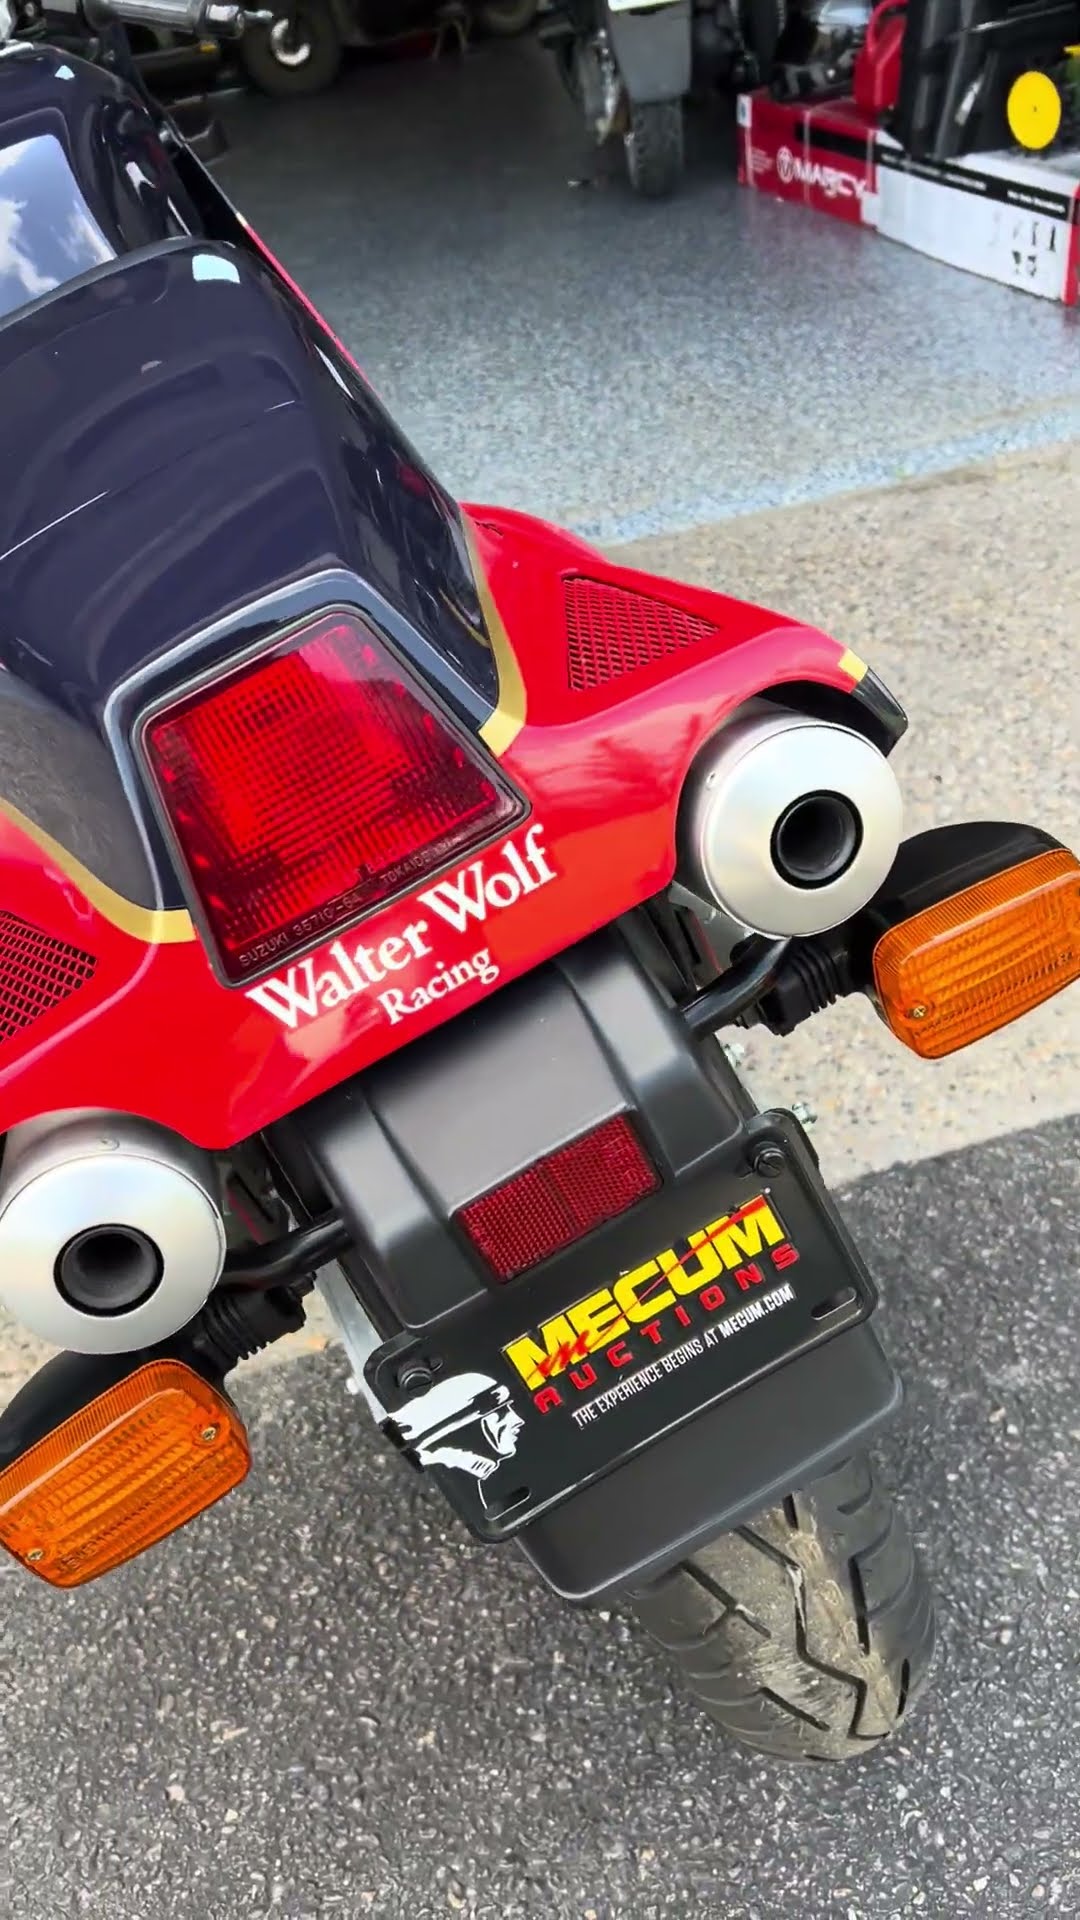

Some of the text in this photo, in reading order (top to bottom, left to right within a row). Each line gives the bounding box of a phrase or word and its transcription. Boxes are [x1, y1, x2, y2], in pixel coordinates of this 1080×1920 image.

[239, 932, 288, 967] SUZUKI
[245, 824, 557, 1029] Walter Wolf
[377, 948, 500, 1025] Racing
[505, 1194, 785, 1391] MECUM
[533, 1243, 800, 1414] AUCTIONS
[571, 1283, 796, 1428] THE EXPERIENCE BEGINS AT MECUM.COM
